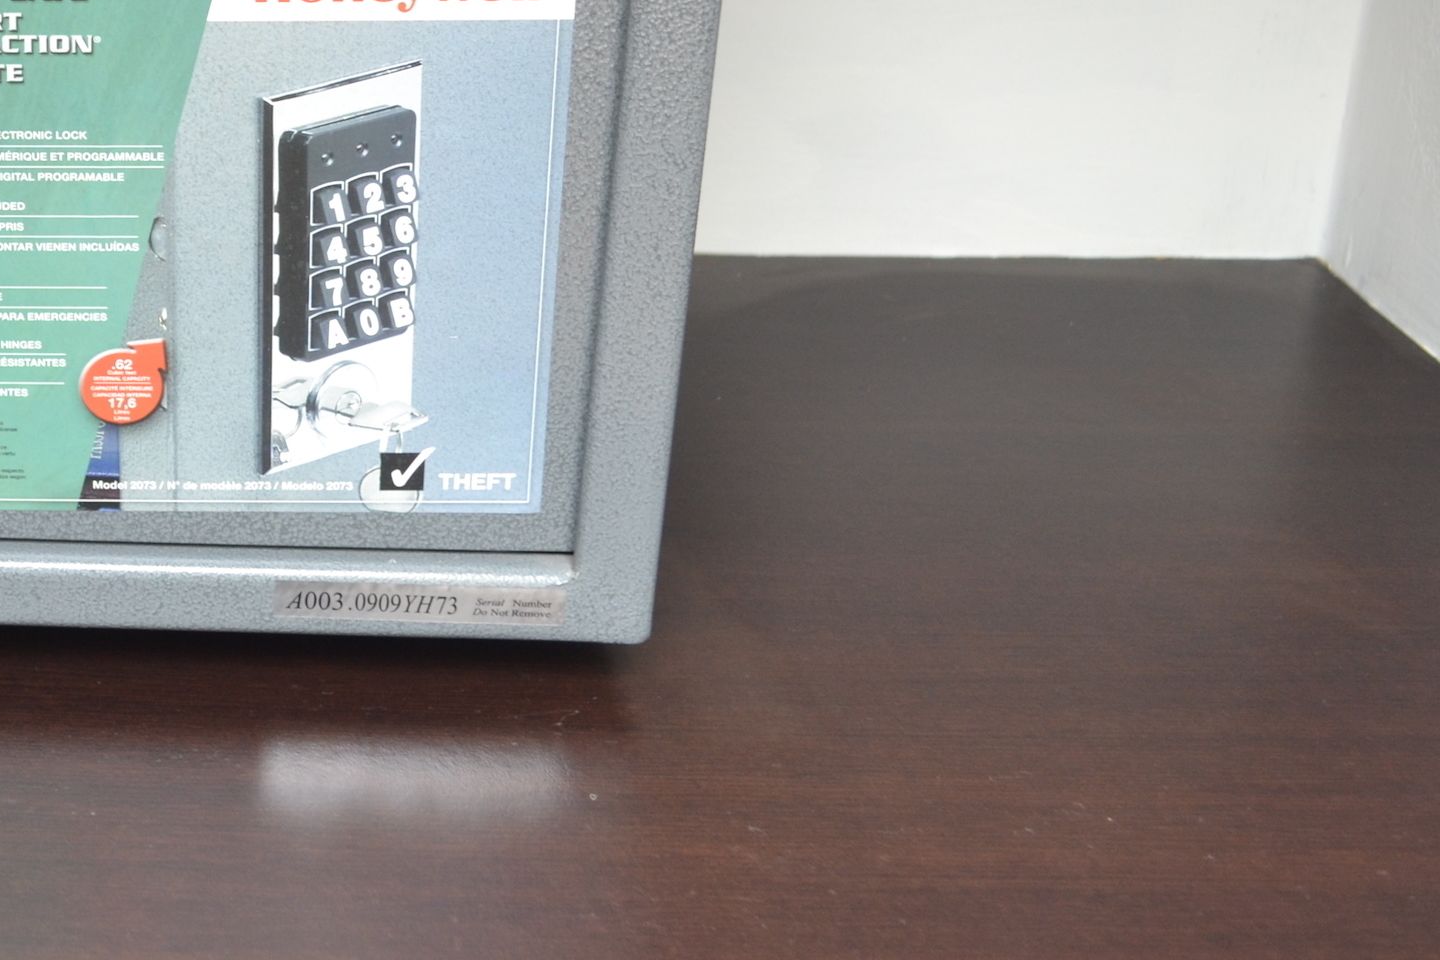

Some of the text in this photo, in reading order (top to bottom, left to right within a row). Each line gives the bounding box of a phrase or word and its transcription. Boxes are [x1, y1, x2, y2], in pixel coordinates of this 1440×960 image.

[55, 131, 87, 140] LOCK
[50, 152, 64, 161] ET
[67, 152, 165, 161] PROGRAMMABLE
[38, 173, 124, 182] PROGRAMABLE
[328, 174, 416, 222] 1 2 3
[327, 216, 415, 263] 4 5 6
[35, 243, 77, 252] VIENEN
[325, 258, 412, 305] 7 8 9
[328, 298, 413, 349] A 0 B
[0, 340, 42, 350] HINGES
[111, 359, 133, 370] .62
[108, 398, 136, 410] 17,6
[92, 480, 127, 490] Model
[130, 480, 156, 490] 2073
[183, 481, 198, 490] de
[244, 481, 271, 491] 2073
[281, 481, 324, 491] Modelo
[326, 481, 353, 491] 2073
[438, 473, 517, 490] THEFT
[475, 598, 552, 609] Serial Number
[472, 607, 551, 618] Do Not Remove
